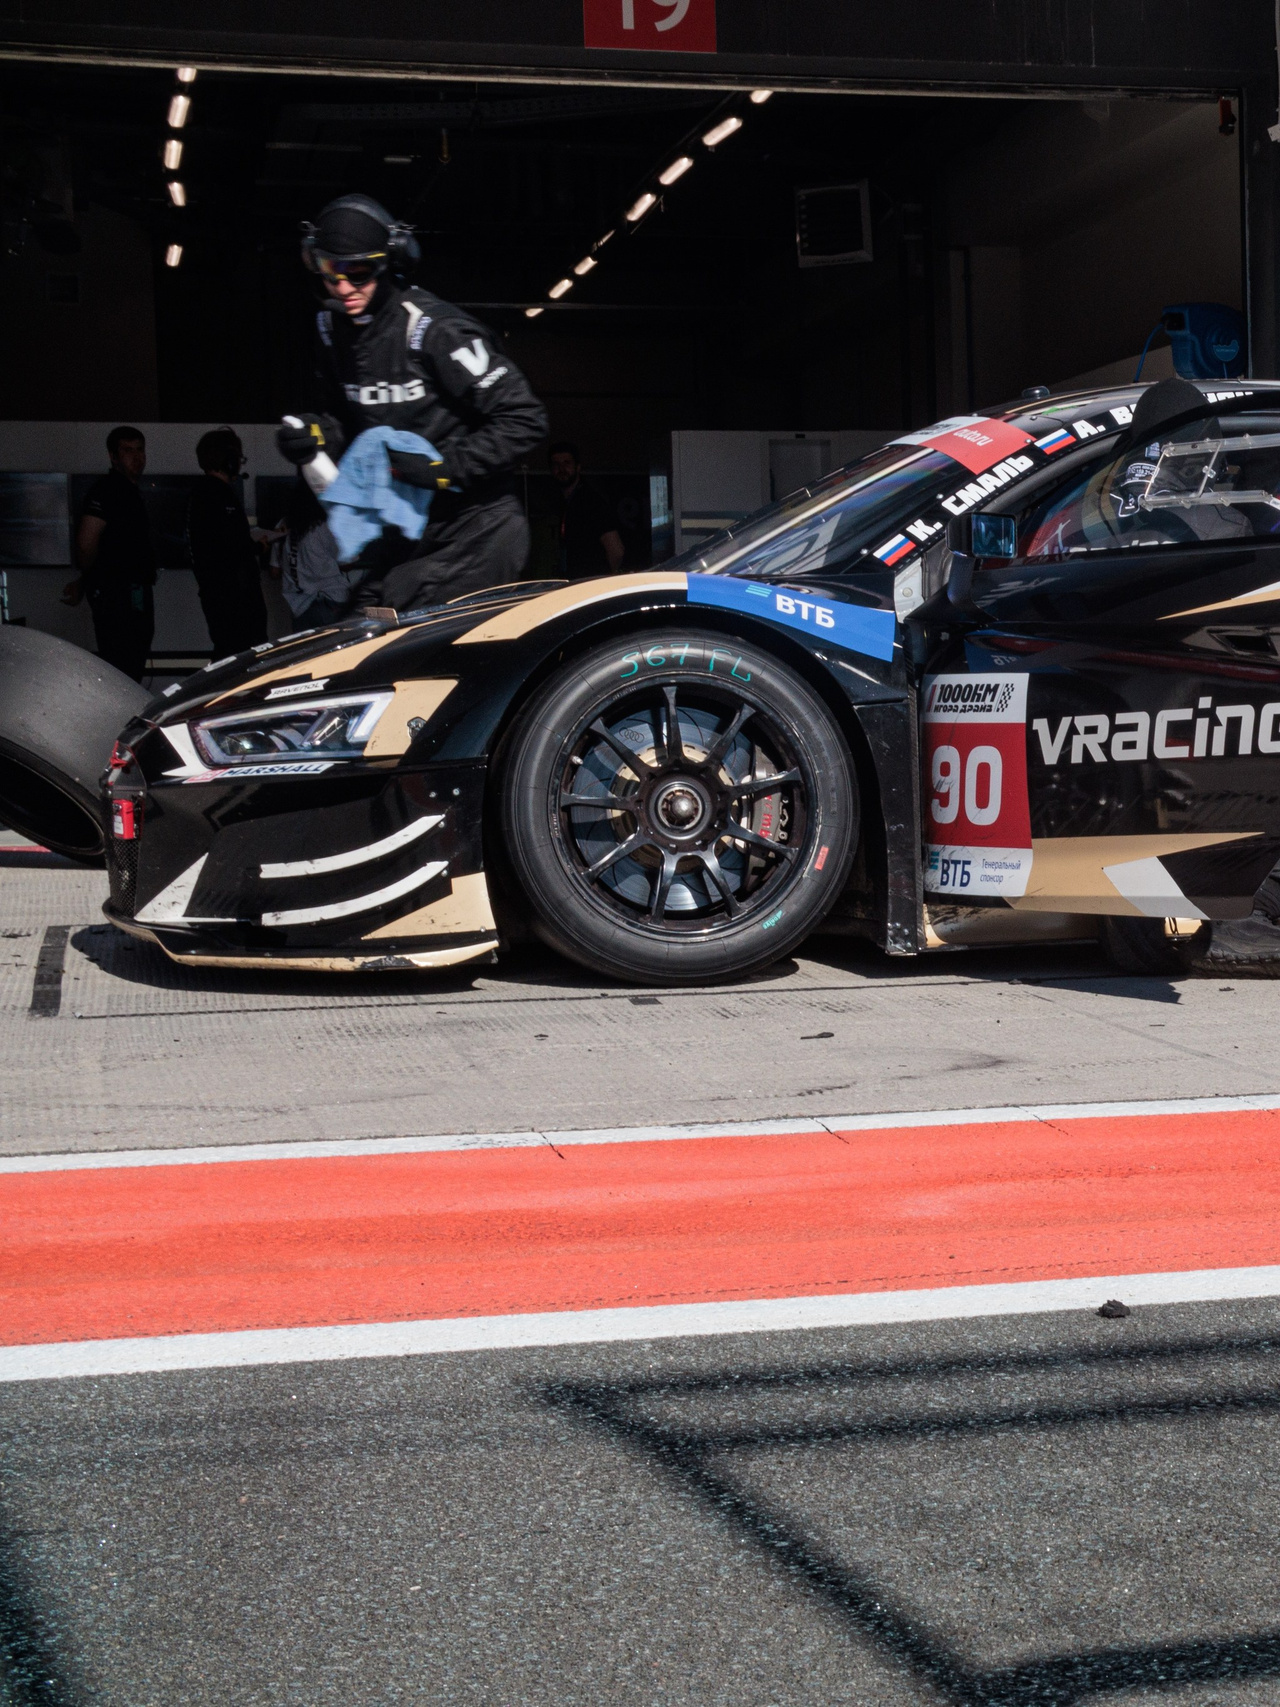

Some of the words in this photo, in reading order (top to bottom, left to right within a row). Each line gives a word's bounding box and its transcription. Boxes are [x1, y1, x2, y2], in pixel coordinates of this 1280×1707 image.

[941, 454, 1035, 517] СМАЛЬ
[775, 593, 836, 629] ВТБ
[272, 682, 321, 697] RAVENOL
[933, 704, 959, 713] ИГОРА
[959, 703, 993, 714] ДРАЙВ
[220, 763, 324, 777] MARSHALL
[930, 745, 1003, 826] 90
[940, 858, 972, 887] ВТБ
[982, 858, 1022, 871] Генеральный
[979, 873, 1004, 885] спонсор
